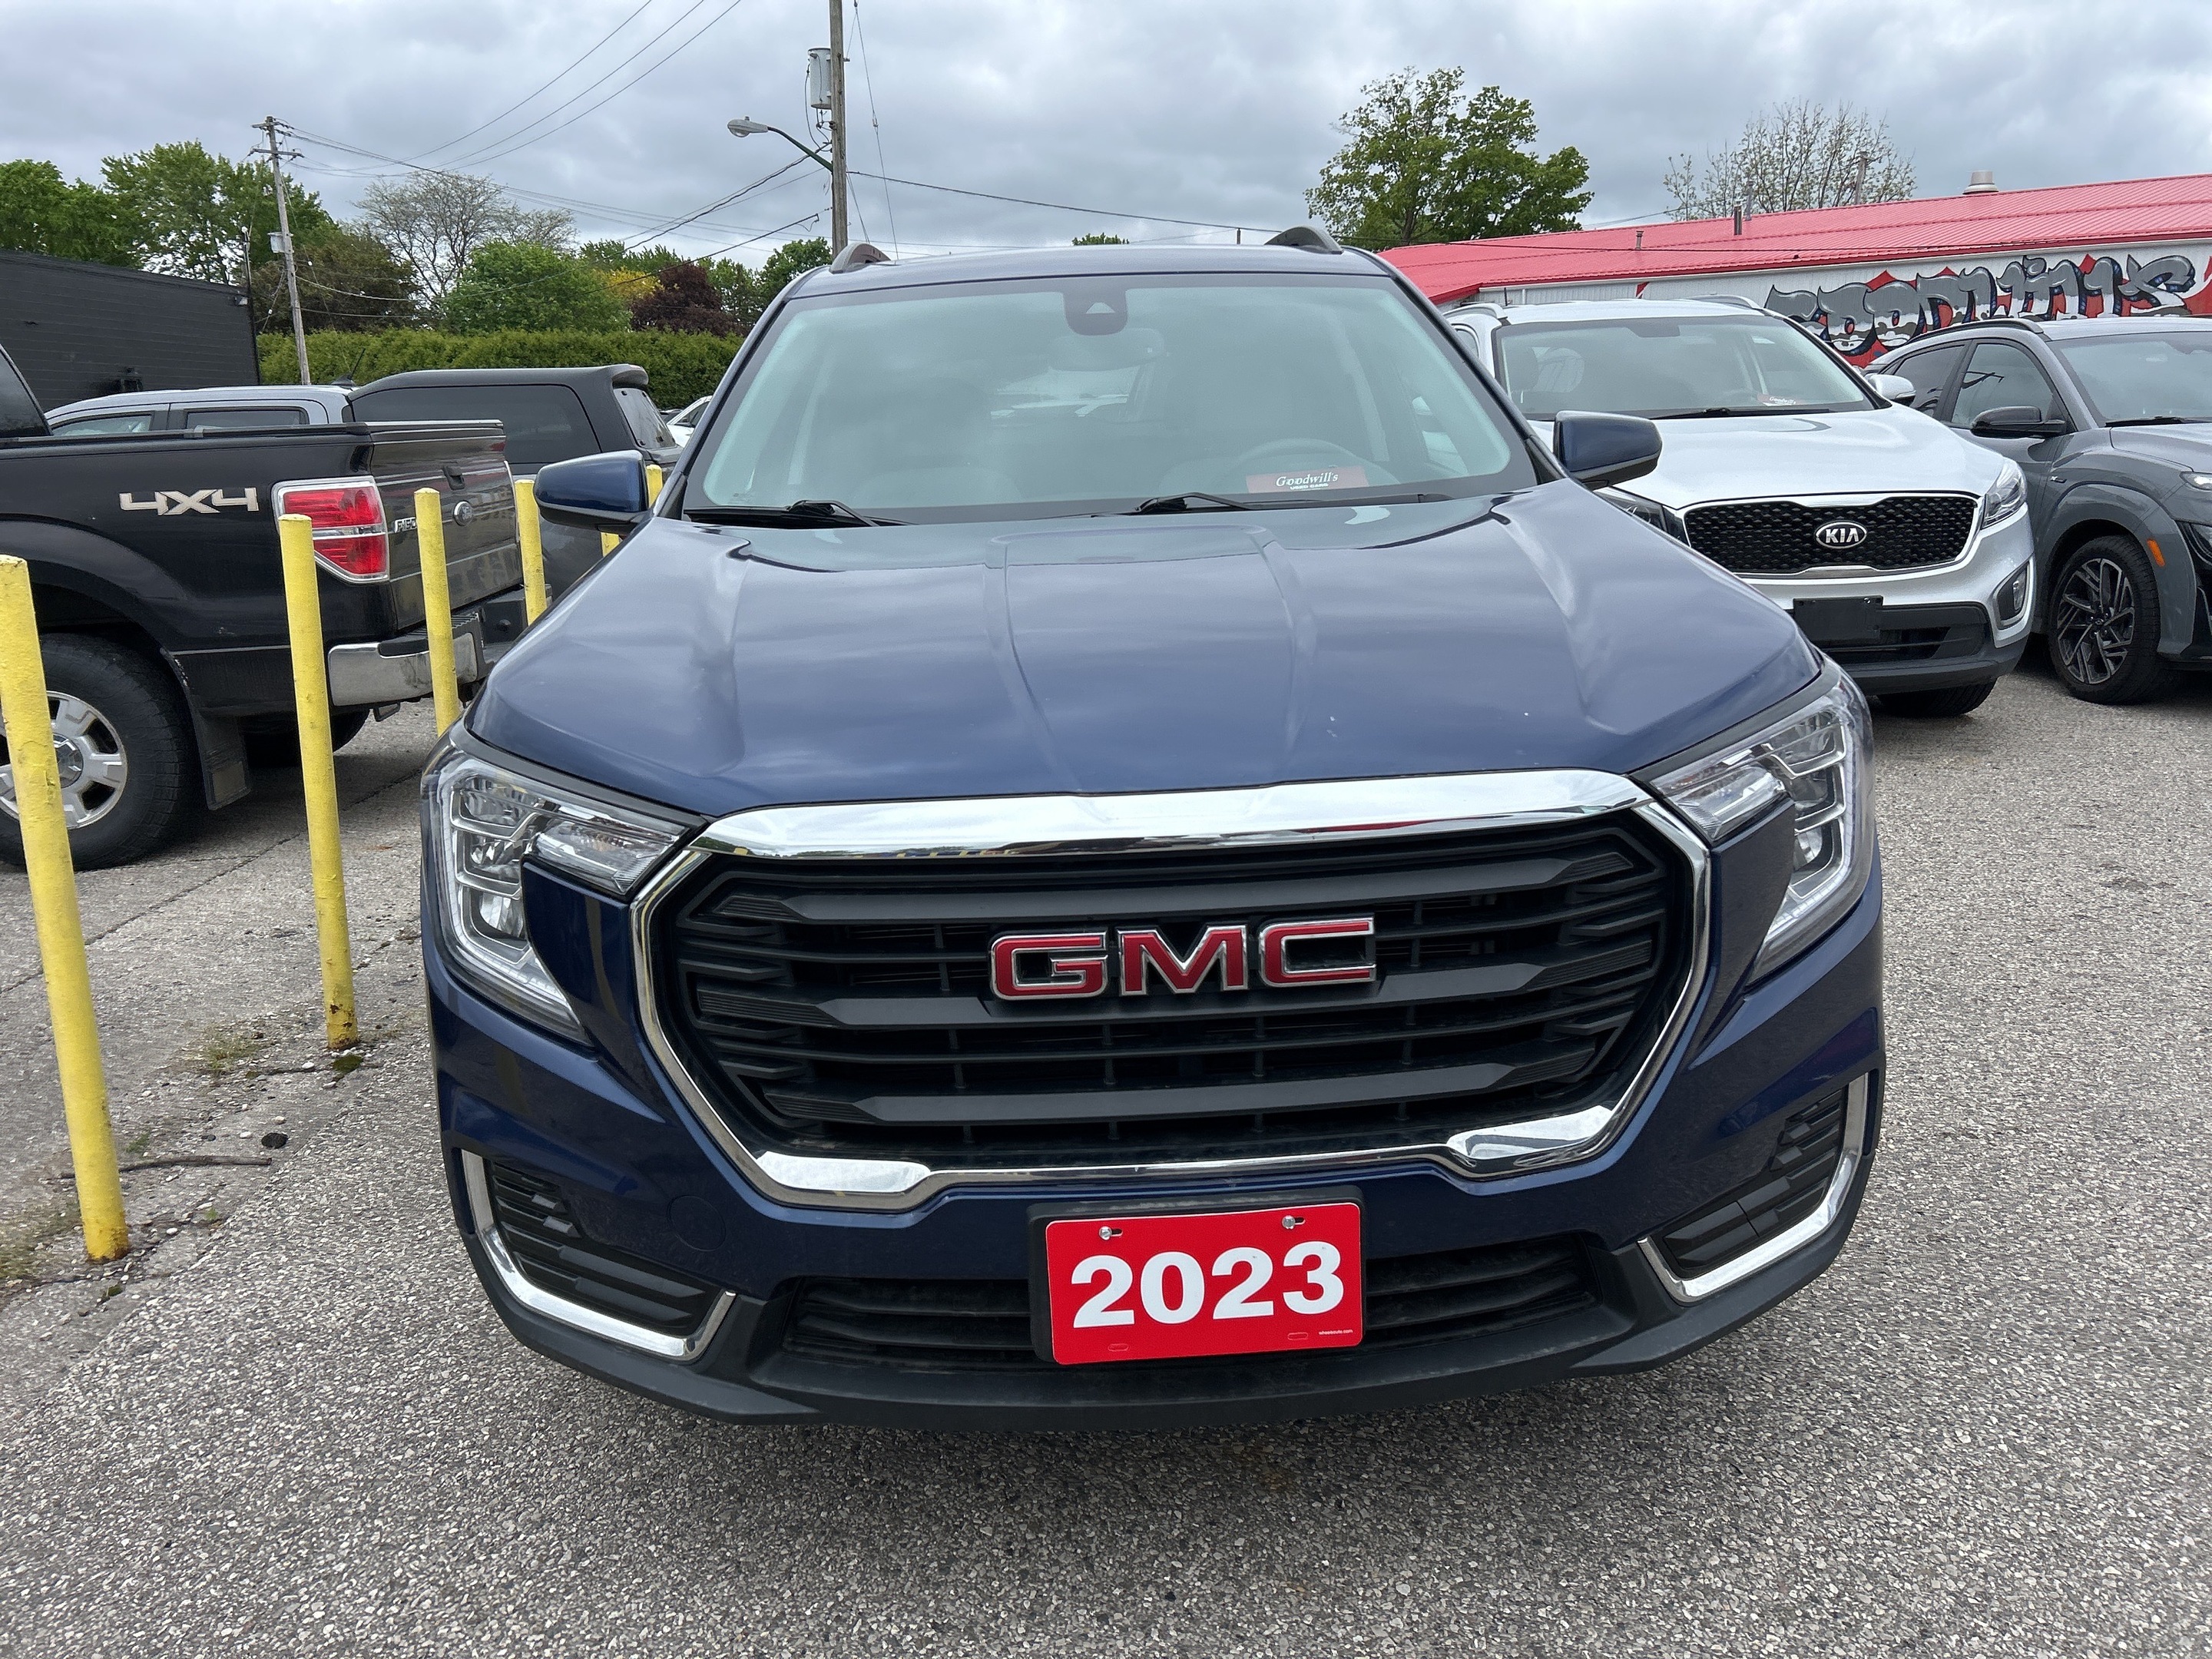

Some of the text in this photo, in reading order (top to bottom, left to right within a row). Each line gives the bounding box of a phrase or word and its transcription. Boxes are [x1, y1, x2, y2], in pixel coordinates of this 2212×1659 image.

[1276, 472, 1339, 487] Goodwill's
[119, 487, 260, 516] 4X4
[1825, 528, 1859, 543] KIA
[990, 918, 1376, 1000] GMC
[1071, 1241, 1344, 1328] 2023
